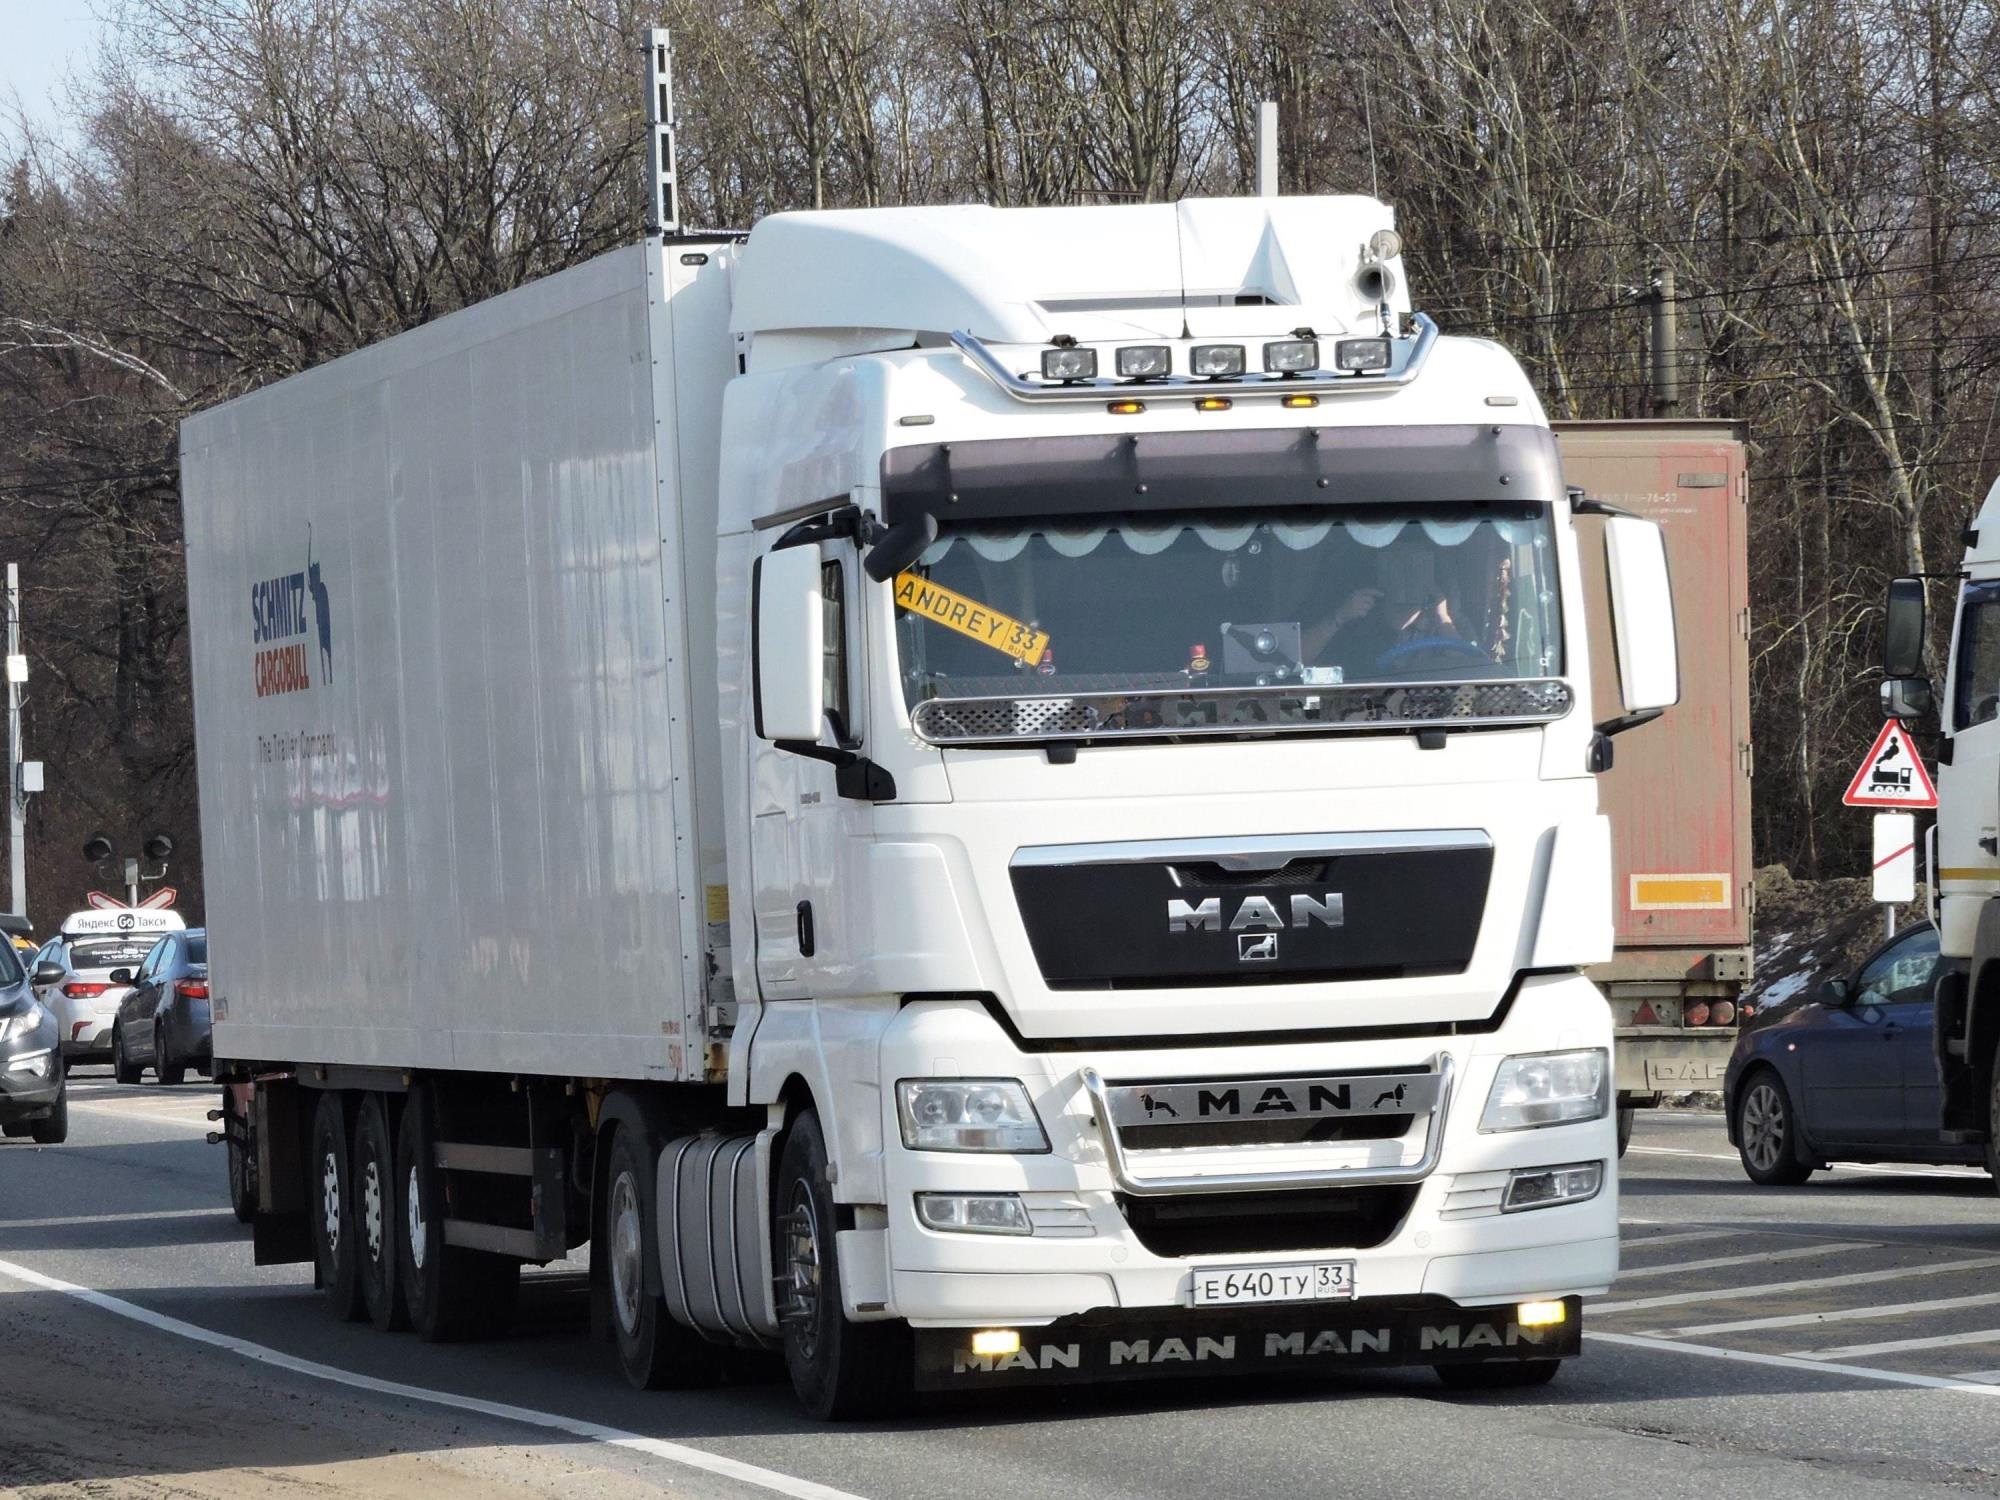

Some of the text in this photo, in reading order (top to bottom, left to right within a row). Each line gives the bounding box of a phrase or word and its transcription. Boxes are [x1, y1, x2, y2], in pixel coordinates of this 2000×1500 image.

[252, 572, 306, 644] SCHMITZ
[899, 581, 1038, 650] ANDREY 33
[255, 643, 309, 697] CARGOBULL
[78, 915, 166, 929] Яндекс Go Такси
[1167, 892, 1344, 932] MAN
[1198, 1084, 1351, 1116] MAN
[1317, 1285, 1337, 1294] RUS
[1318, 1266, 1342, 1286] 33
[953, 1321, 1546, 1373] MAN MAN MAN MAN
